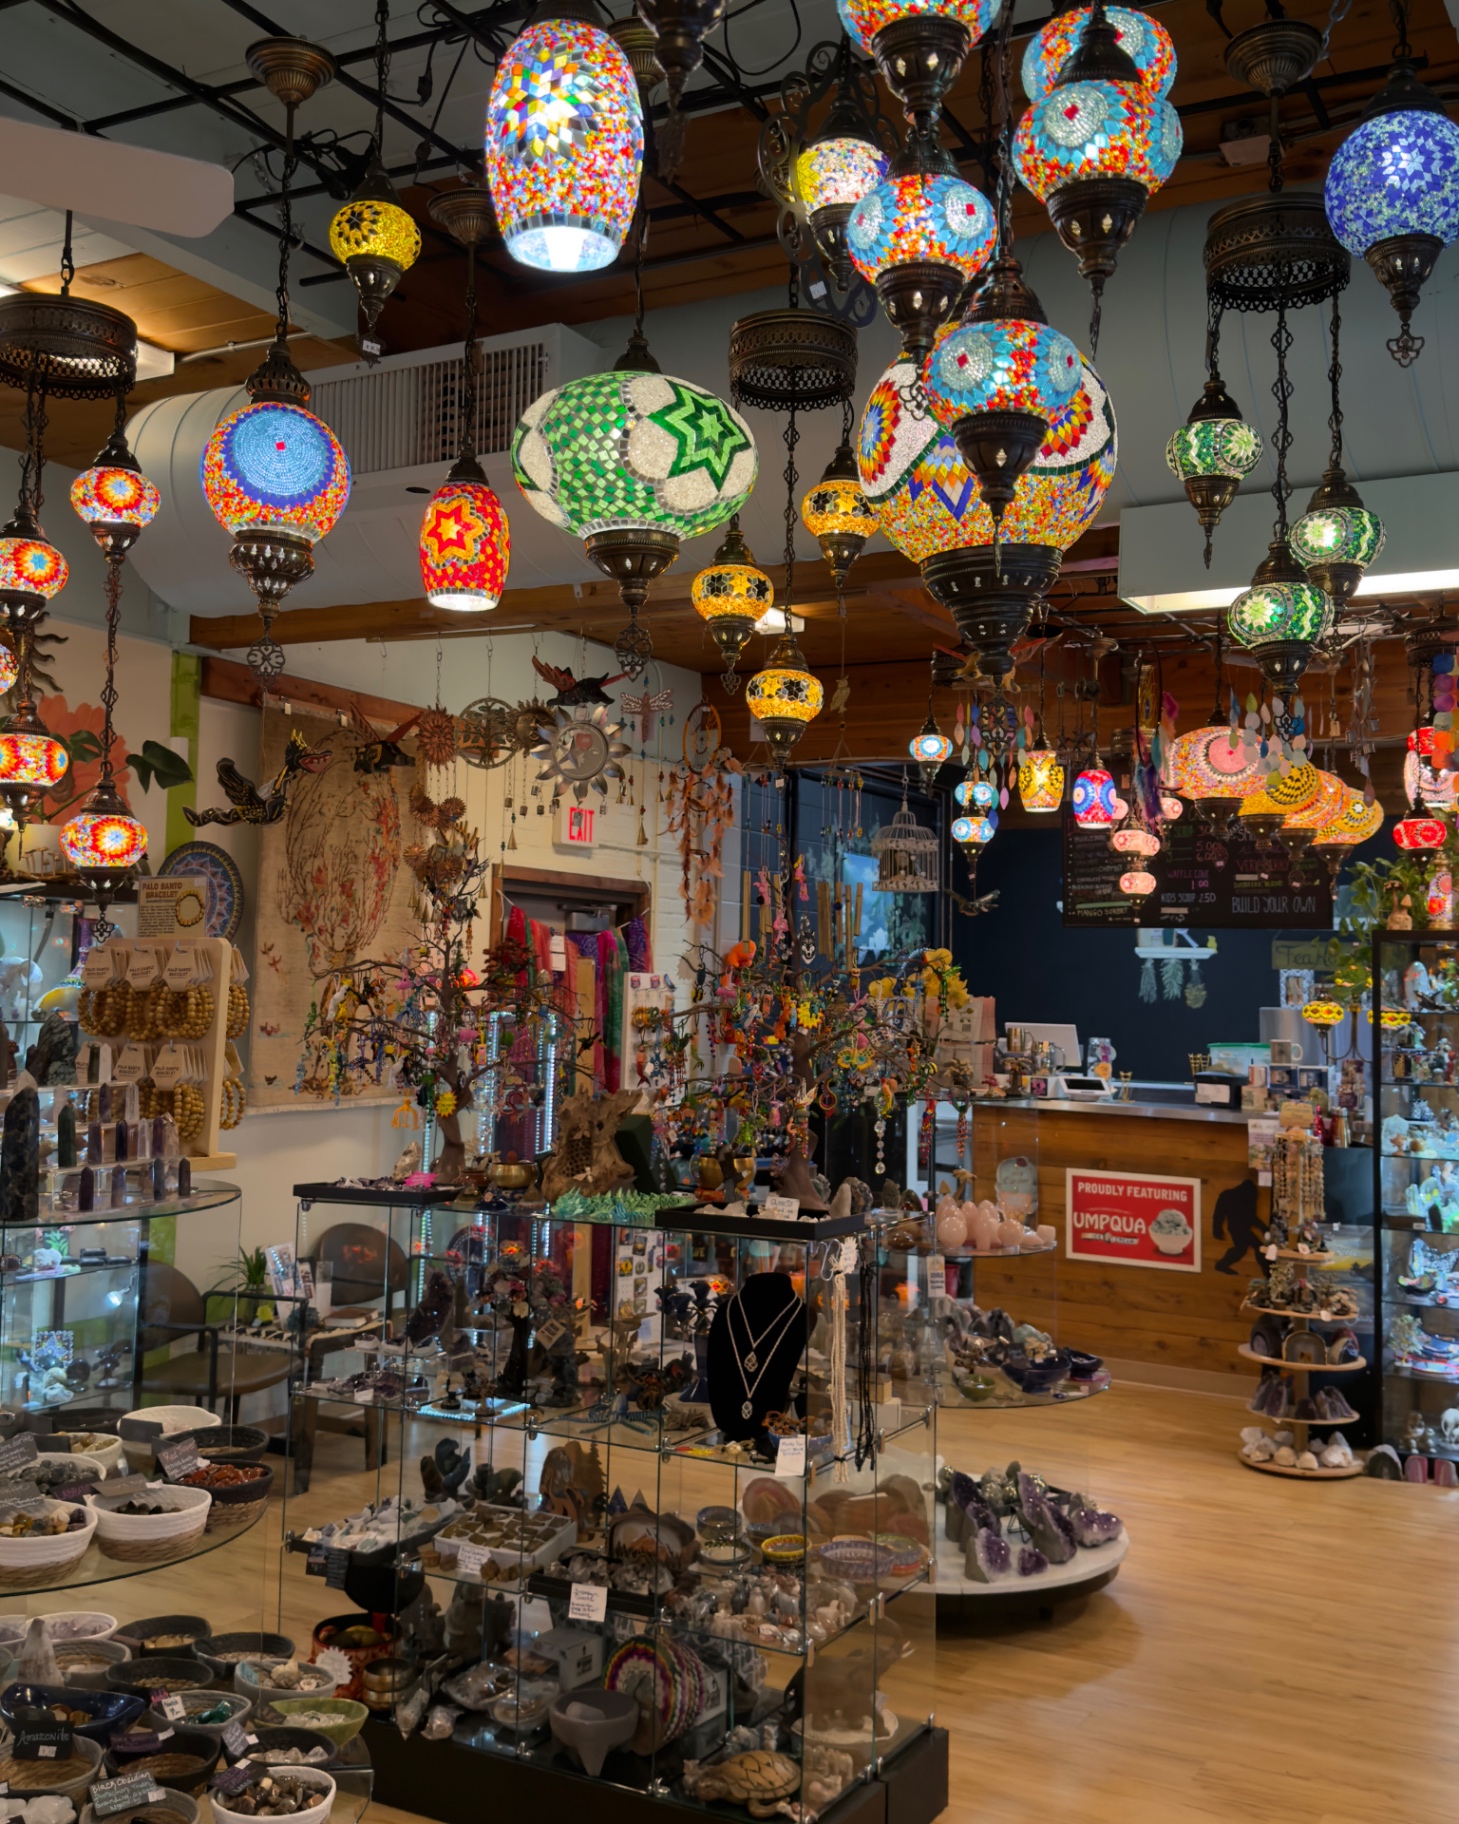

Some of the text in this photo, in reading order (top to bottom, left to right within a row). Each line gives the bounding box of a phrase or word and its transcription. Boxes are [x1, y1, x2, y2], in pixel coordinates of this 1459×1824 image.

[142, 882, 183, 890] PALO SANTO
[145, 890, 178, 899] BRACELET
[1077, 908, 1103, 918] MANGO
[1231, 896, 1316, 914] BUILD YOUR OWN
[1078, 1181, 1188, 1202] PROUDLY FEATURING
[1073, 1211, 1146, 1235] UMPQUA
[91, 1771, 153, 1794] Black Obsidian
